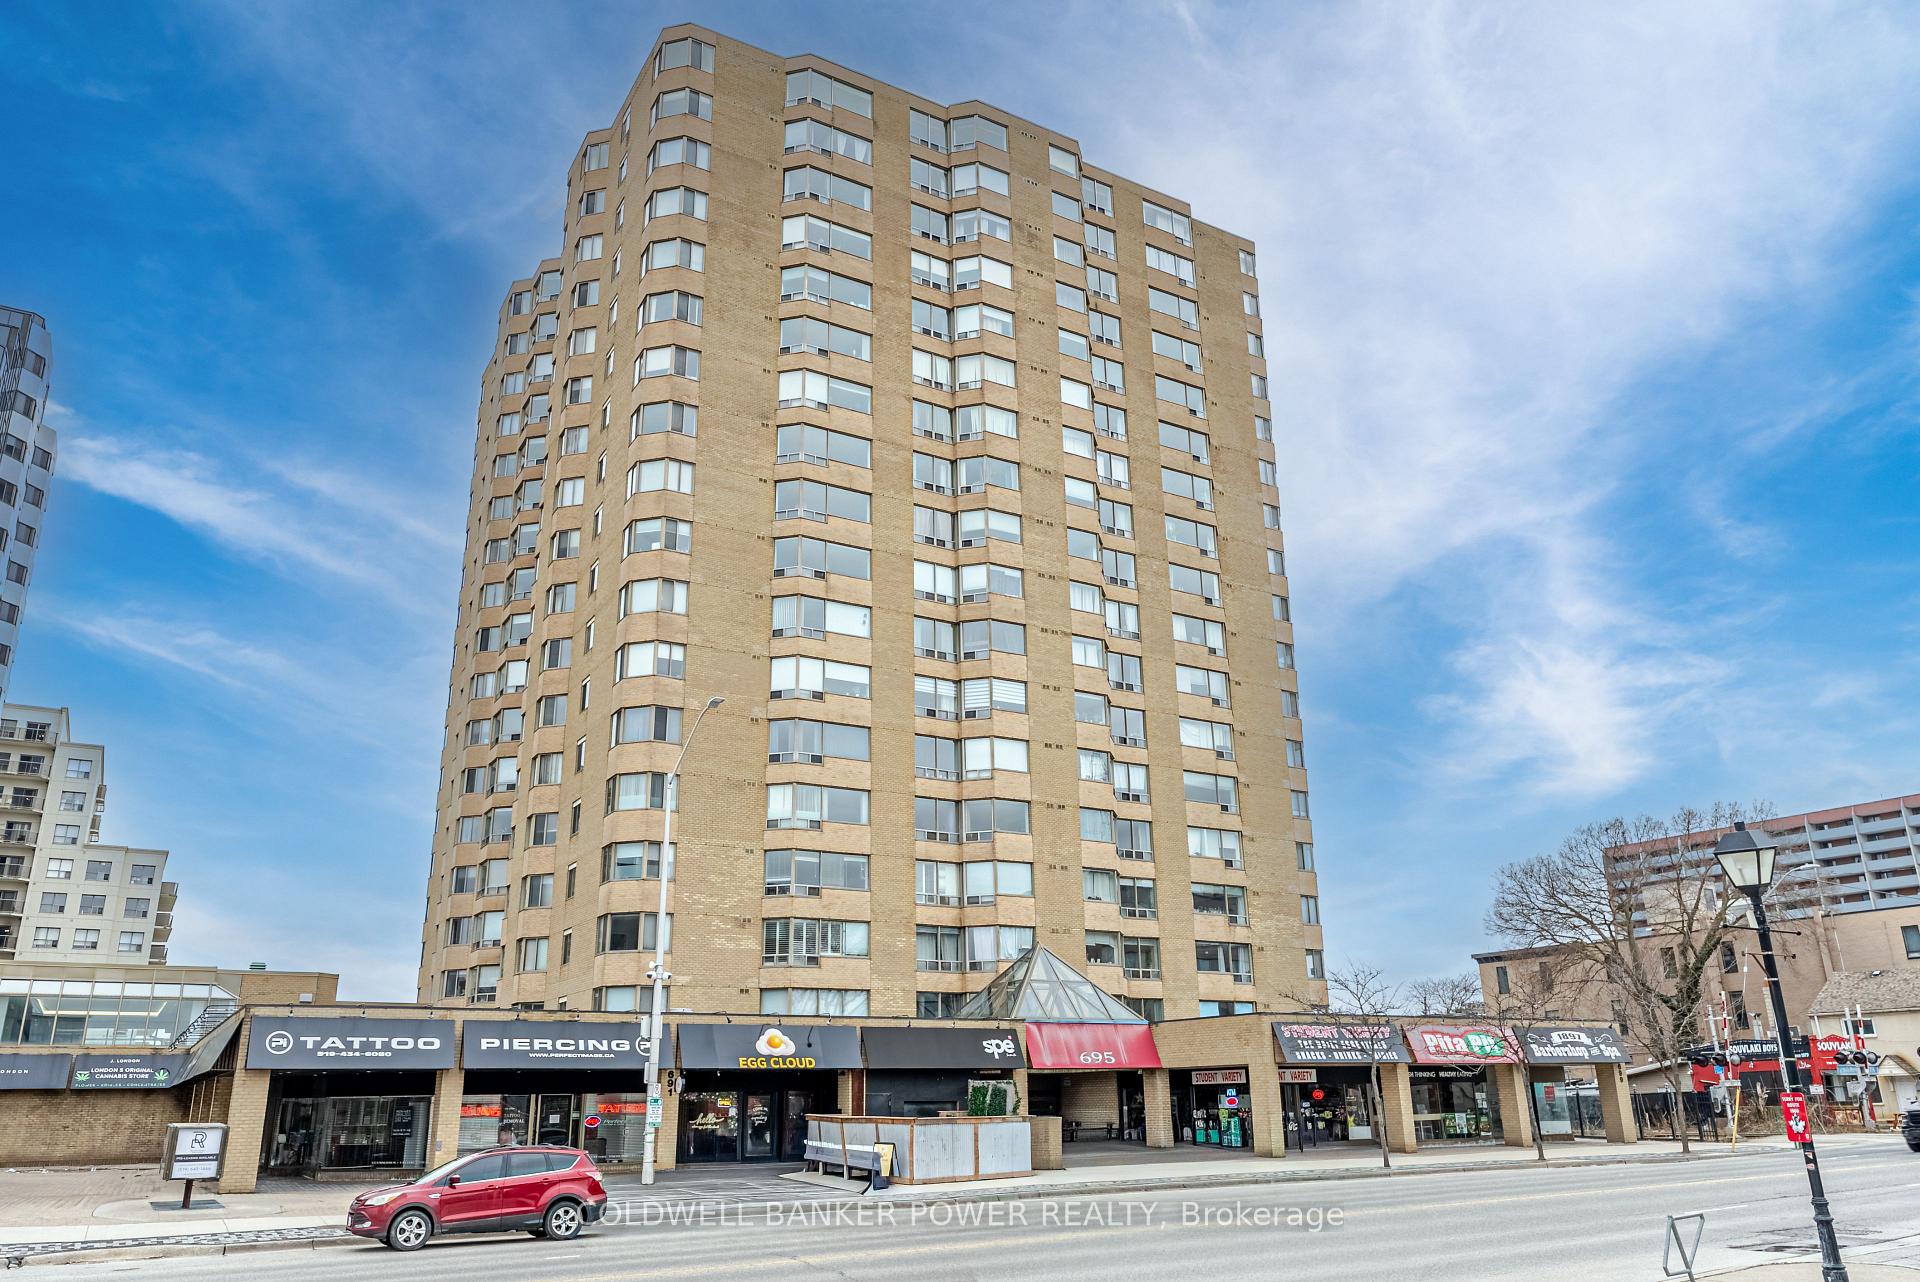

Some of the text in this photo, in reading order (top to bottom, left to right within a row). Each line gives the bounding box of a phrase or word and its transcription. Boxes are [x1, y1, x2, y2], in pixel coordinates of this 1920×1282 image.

[1557, 1033, 1581, 1041] 1897
[300, 1037, 441, 1049] TATTOO
[480, 1038, 630, 1051] PIERCING
[1422, 1034, 1470, 1053] Pita
[1729, 1044, 1778, 1053] SOUVLAKI BOYS
[1296, 1051, 1327, 1060] SNACKS
[1530, 1044, 1590, 1059] Barbershop
[1599, 1044, 1622, 1059] Spa
[738, 1057, 816, 1068] EGG CLOUD
[1080, 1051, 1115, 1064] 695
[1195, 1071, 1243, 1082] STUDENT VARIETY
[1290, 1071, 1313, 1080] VARIETY
[667, 1070, 675, 1097] 691
